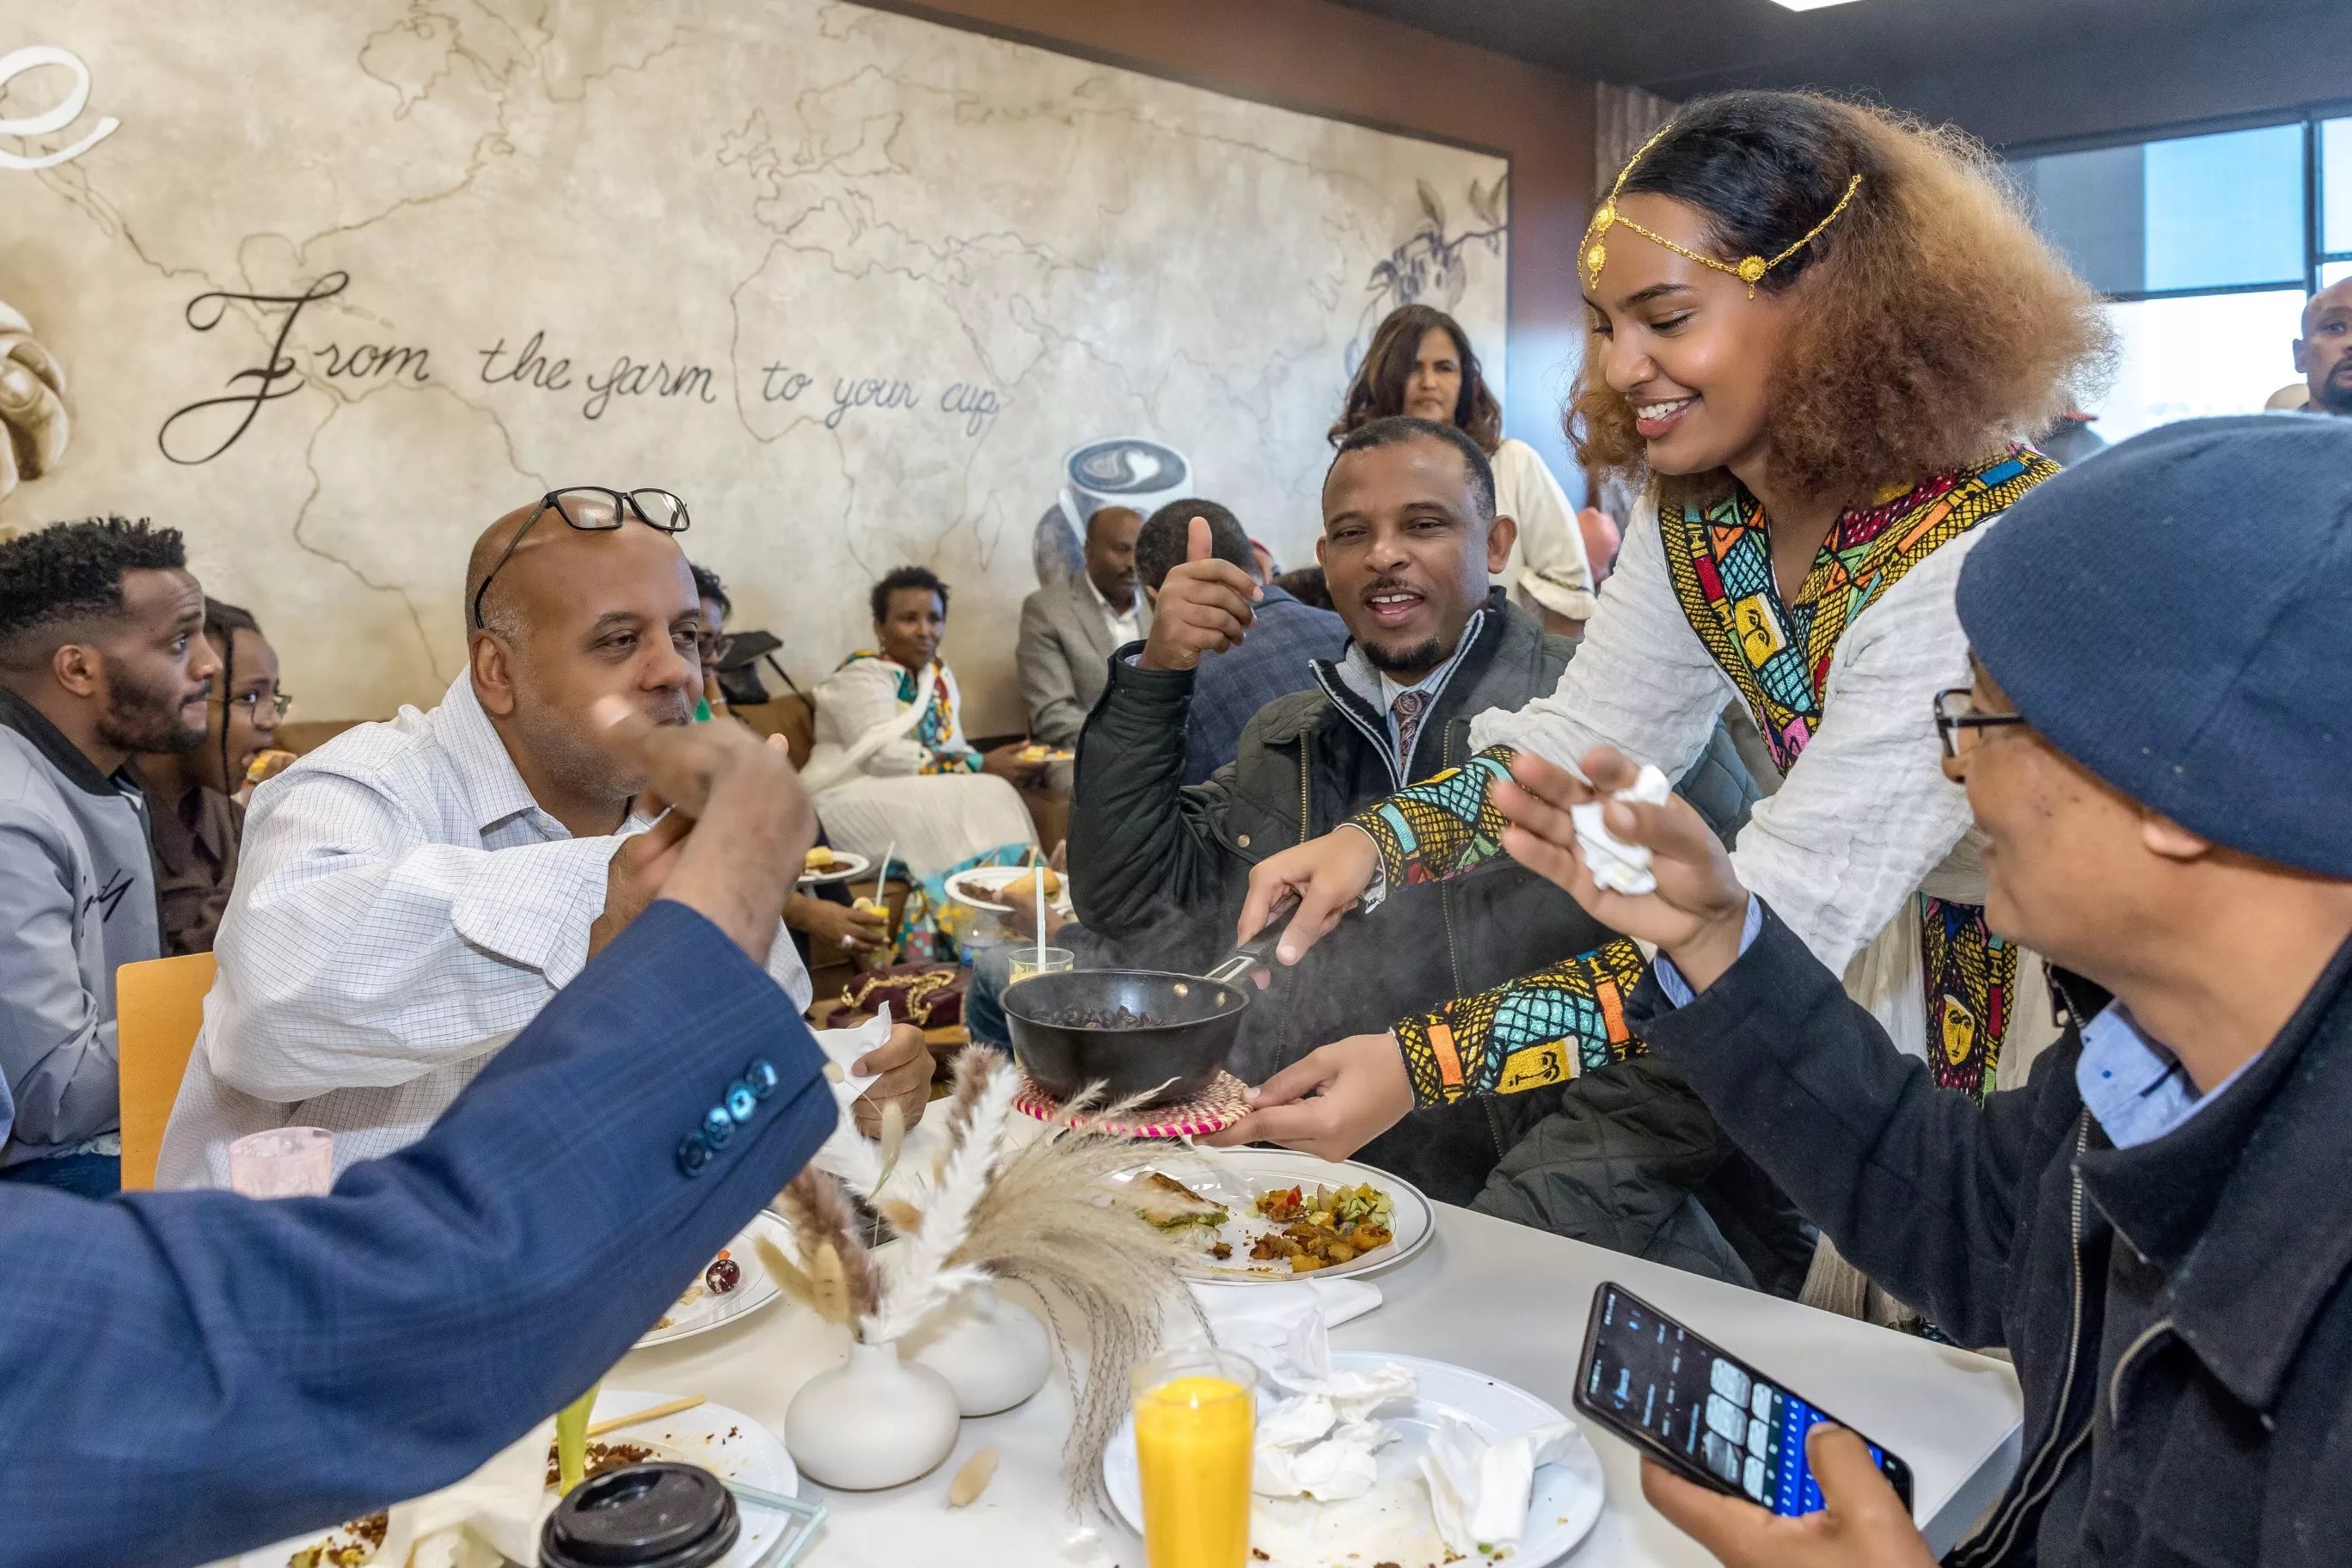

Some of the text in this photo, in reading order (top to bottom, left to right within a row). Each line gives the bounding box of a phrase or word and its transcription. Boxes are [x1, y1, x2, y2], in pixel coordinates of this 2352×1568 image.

[158, 271, 431, 465] From
[480, 330, 573, 392] the
[762, 360, 813, 403] to
[824, 375, 919, 430] your
[940, 381, 1001, 436] cup
